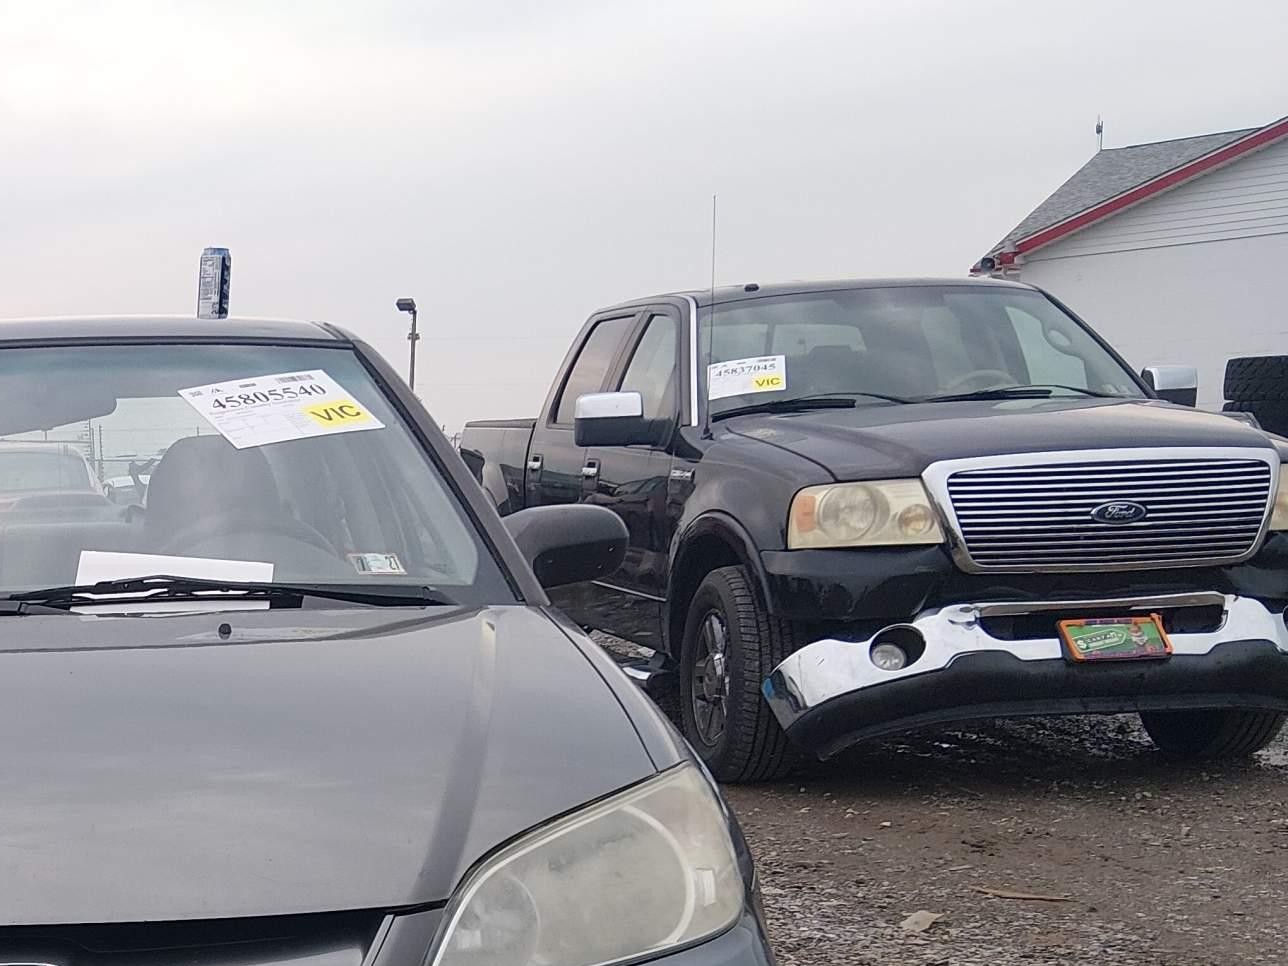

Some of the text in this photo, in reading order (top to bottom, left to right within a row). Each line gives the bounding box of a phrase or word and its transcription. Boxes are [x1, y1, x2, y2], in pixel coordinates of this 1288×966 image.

[715, 362, 777, 377] 45837045
[755, 377, 781, 387] VIC
[211, 382, 327, 410] 45805540
[310, 404, 362, 422] VIC
[1104, 503, 1136, 519] Ford
